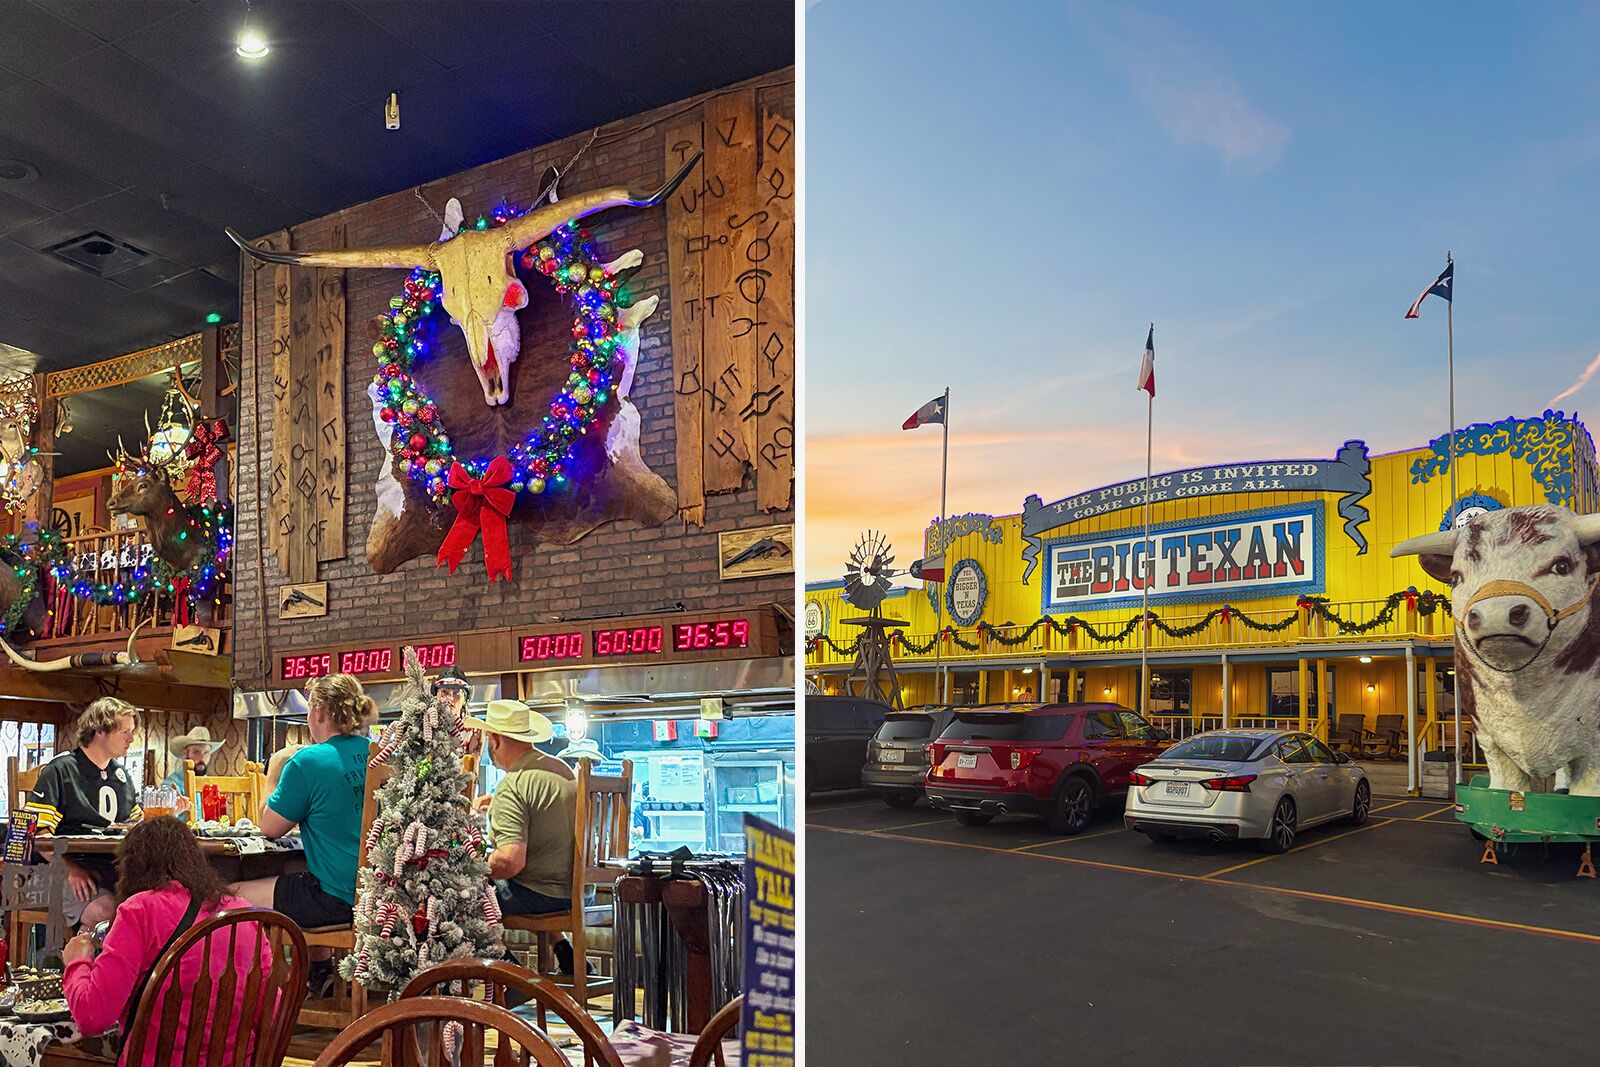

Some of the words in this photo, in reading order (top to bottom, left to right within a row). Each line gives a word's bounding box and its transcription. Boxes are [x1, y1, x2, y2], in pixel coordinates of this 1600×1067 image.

[1053, 494, 1092, 513] THE
[1100, 475, 1171, 499] PUBLIC
[1181, 470, 1203, 484] IS
[1213, 464, 1319, 480] INVITED
[1073, 499, 1123, 519] COME
[1130, 490, 1168, 505] ONE
[1176, 482, 1232, 497] COME
[1242, 478, 1285, 490] ALL
[1057, 559, 1093, 586] THE
[1090, 539, 1156, 595] BIG
[1162, 520, 1305, 587] TEXAN
[955, 582, 978, 592] BIGGER
[956, 600, 976, 609] TEXAS
[807, 616, 816, 626] 66
[597, 627, 664, 655] 60:00
[677, 619, 749, 649] 36:59
[403, 644, 456, 668] 0:00
[522, 634, 584, 661] 60:00
[284, 655, 331, 679] 36:59
[342, 650, 392, 674] 60:00
